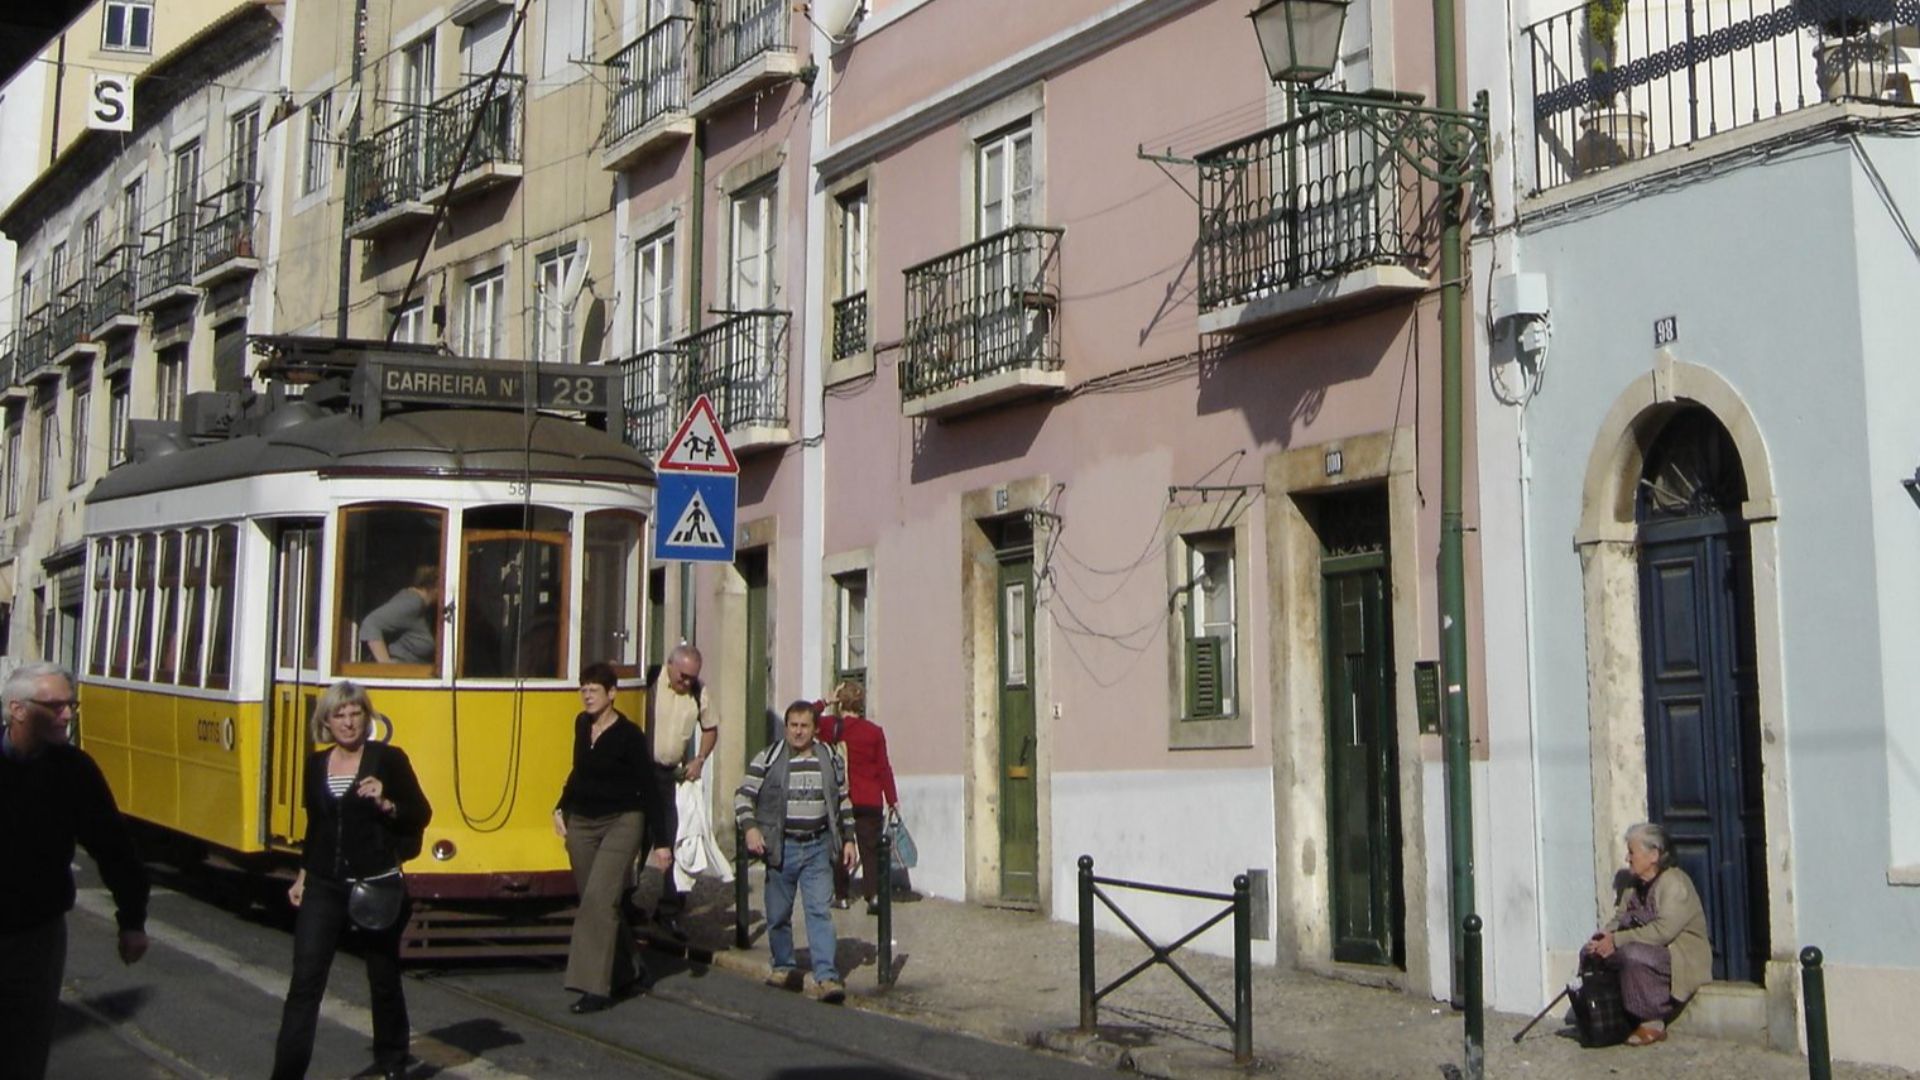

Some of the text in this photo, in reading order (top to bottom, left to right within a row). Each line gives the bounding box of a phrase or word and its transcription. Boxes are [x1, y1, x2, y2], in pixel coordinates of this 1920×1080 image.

[94, 80, 124, 123] S
[1657, 319, 1673, 342] 98
[386, 370, 488, 396] CARREIRA
[553, 377, 595, 405] 28
